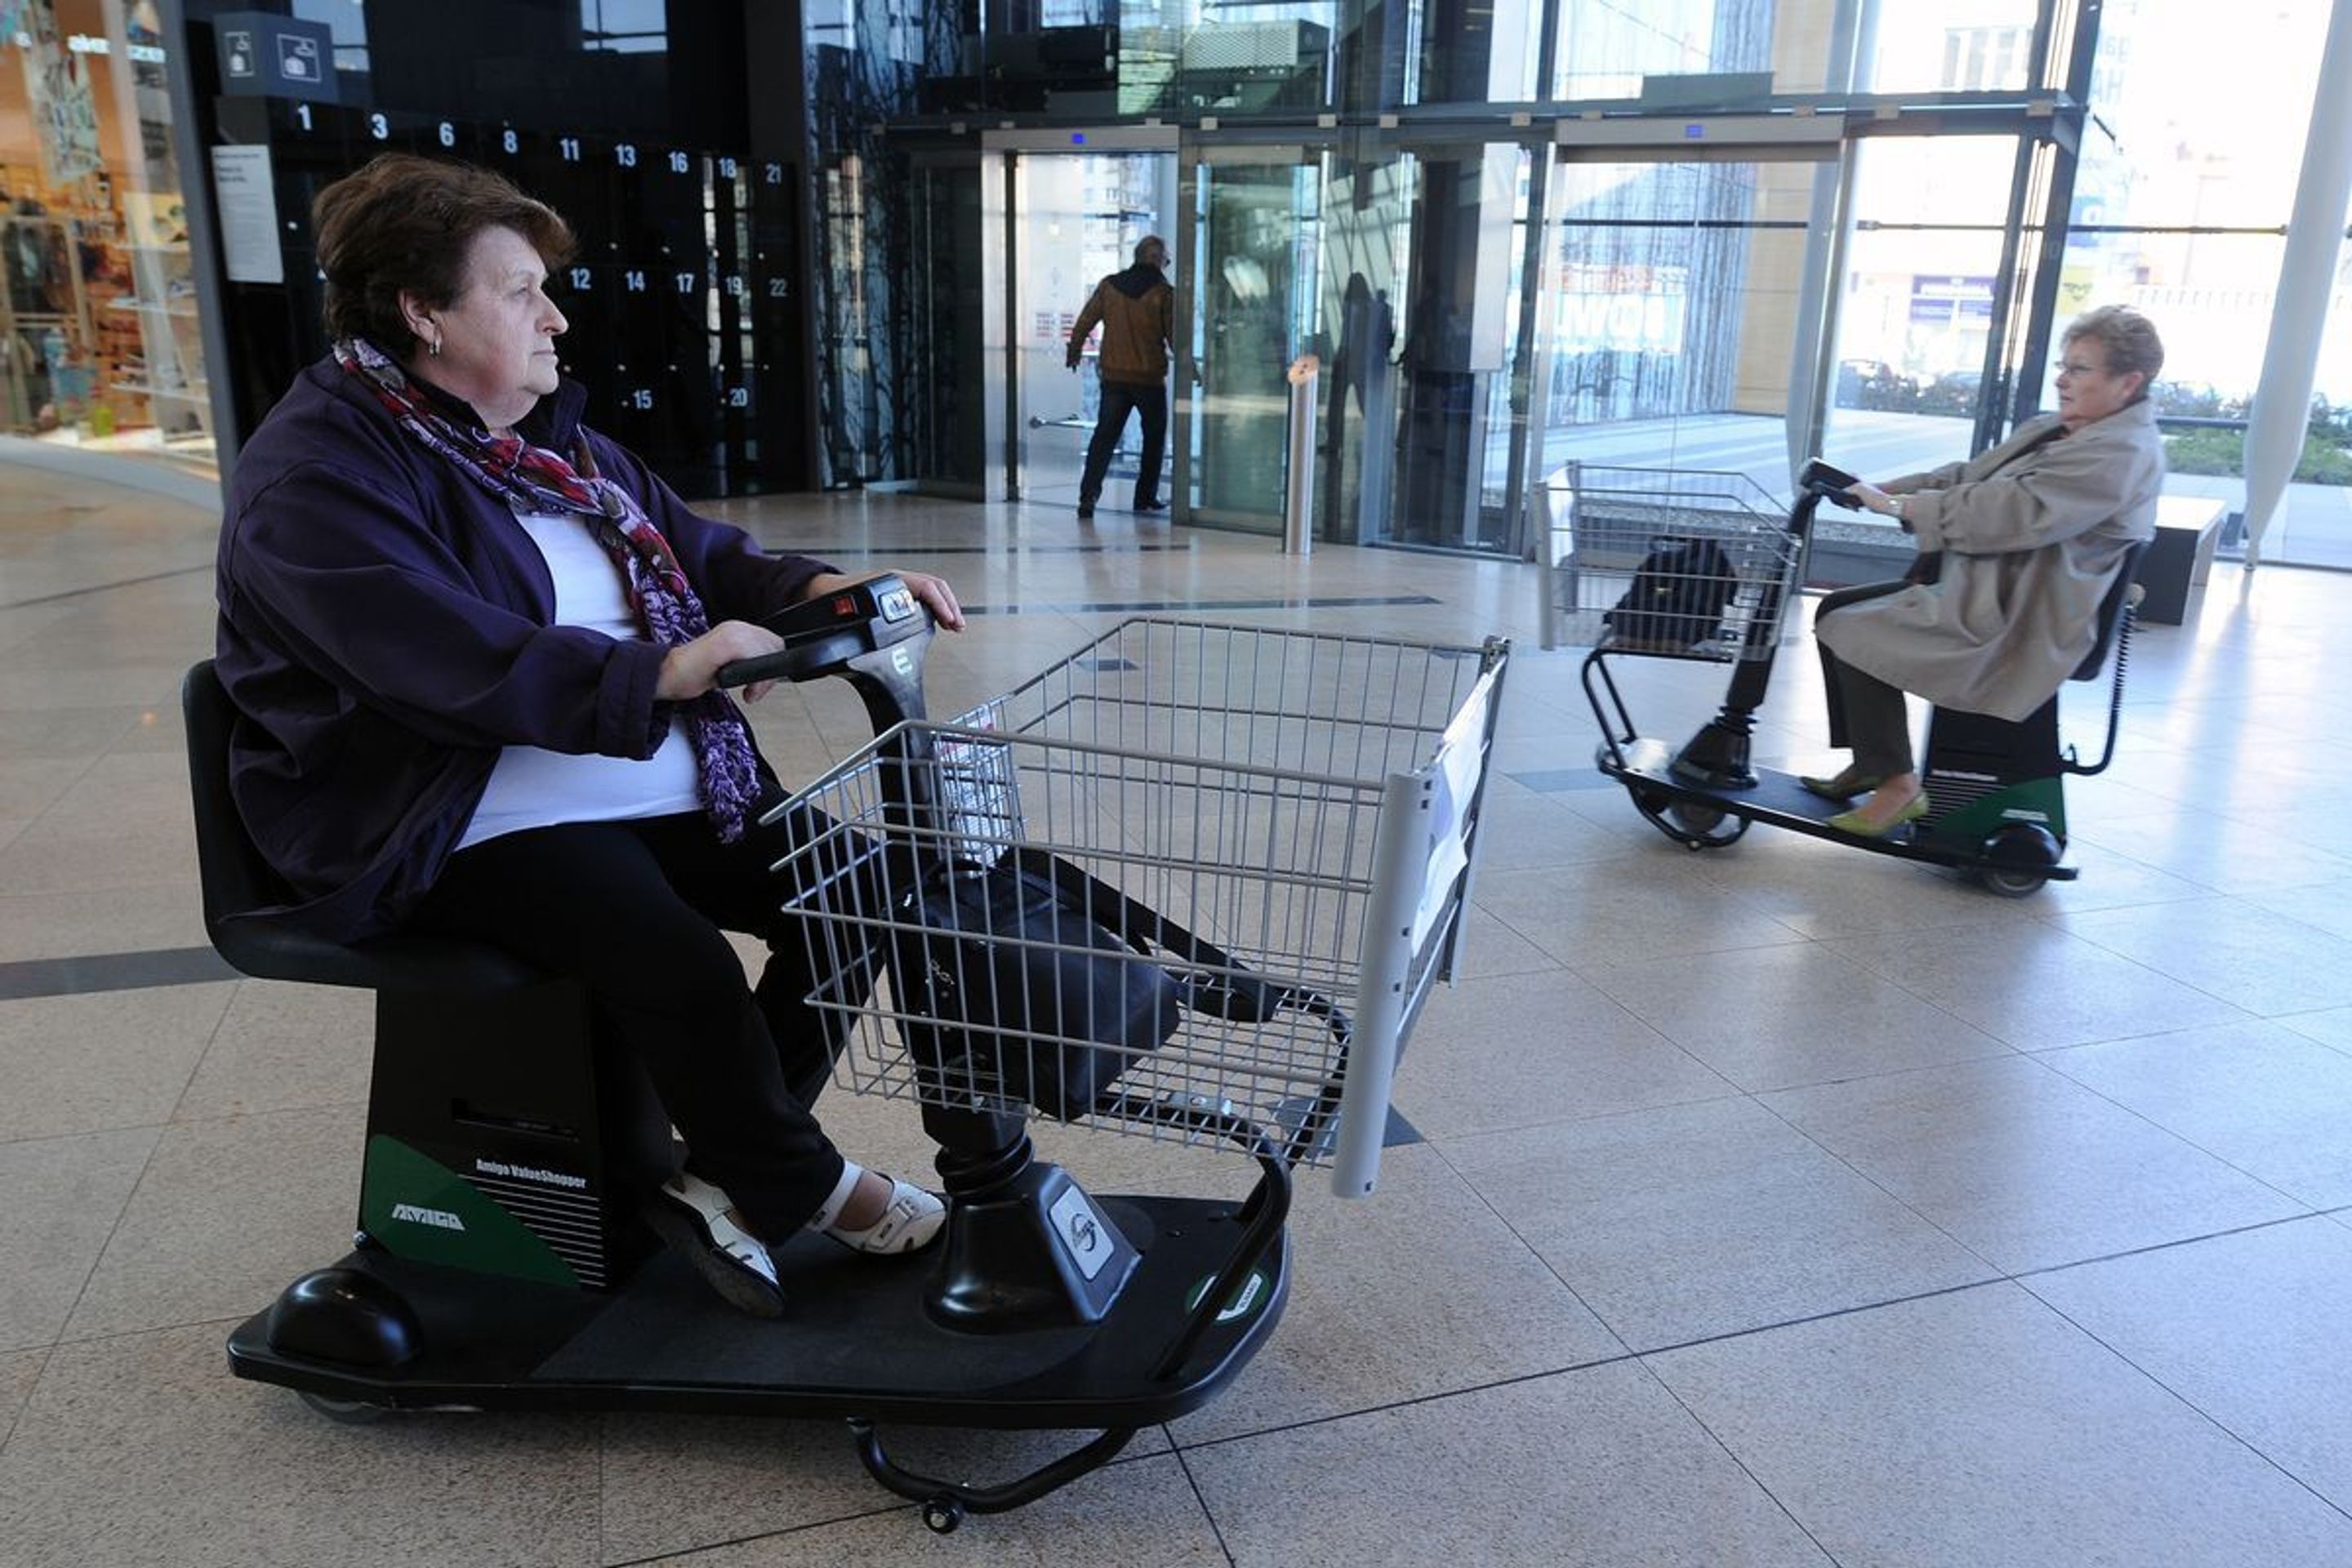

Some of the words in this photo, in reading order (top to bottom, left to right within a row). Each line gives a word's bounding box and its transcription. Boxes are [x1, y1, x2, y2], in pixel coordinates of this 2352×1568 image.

[298, 104, 312, 131] 1
[371, 113, 389, 140] 3
[439, 122, 455, 146] 6
[504, 130, 518, 154] 8
[560, 138, 580, 161] 11
[614, 144, 636, 167] 13
[668, 151, 689, 173] 16
[719, 158, 737, 179] 18
[766, 163, 782, 184] 21
[570, 268, 591, 290] 12
[626, 270, 645, 292] 14
[676, 273, 694, 293] 17
[726, 275, 743, 296] 19
[769, 278, 786, 297] 22
[633, 390, 653, 409] 15
[729, 388, 748, 407] 20
[476, 1158, 510, 1176] Amigo
[510, 1165, 586, 1189] ValueShopper
